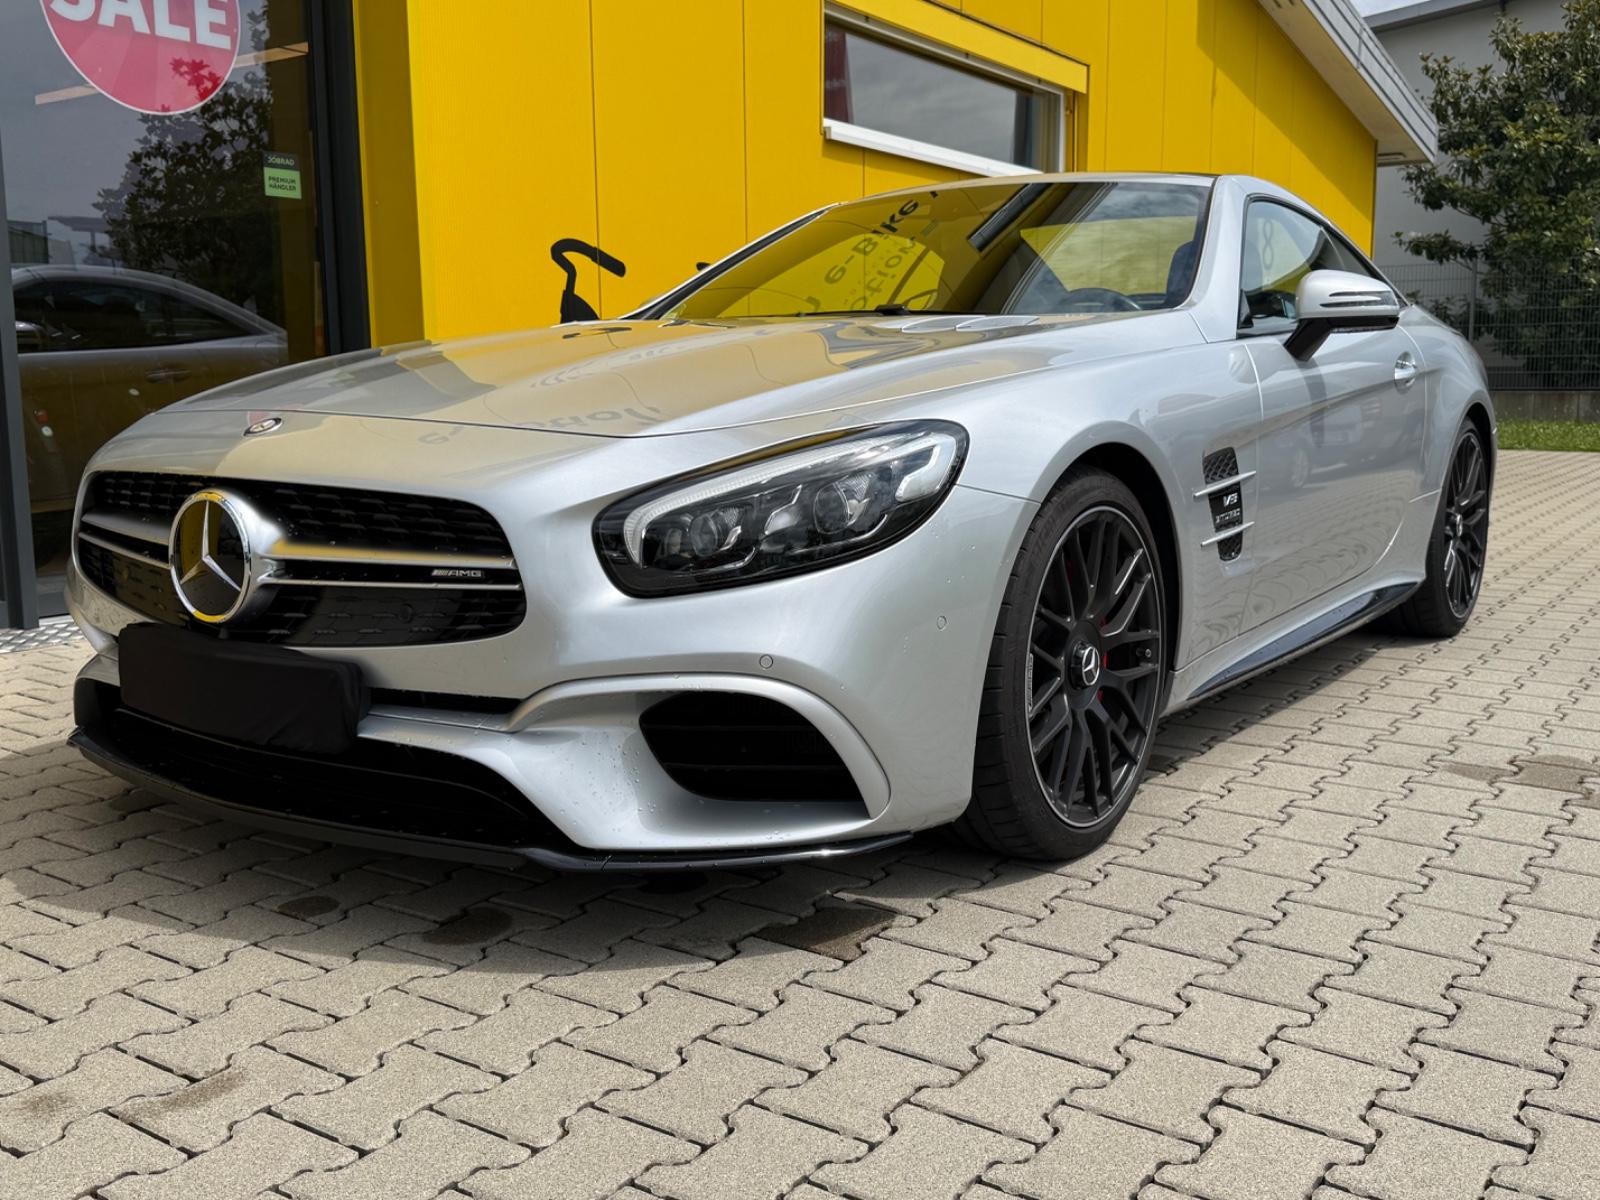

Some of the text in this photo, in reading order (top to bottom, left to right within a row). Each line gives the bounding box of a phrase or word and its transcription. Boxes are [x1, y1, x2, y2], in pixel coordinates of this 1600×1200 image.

[269, 176, 296, 185] PREMIUM
[1223, 493, 1238, 507] V8
[445, 569, 482, 577] AMG
